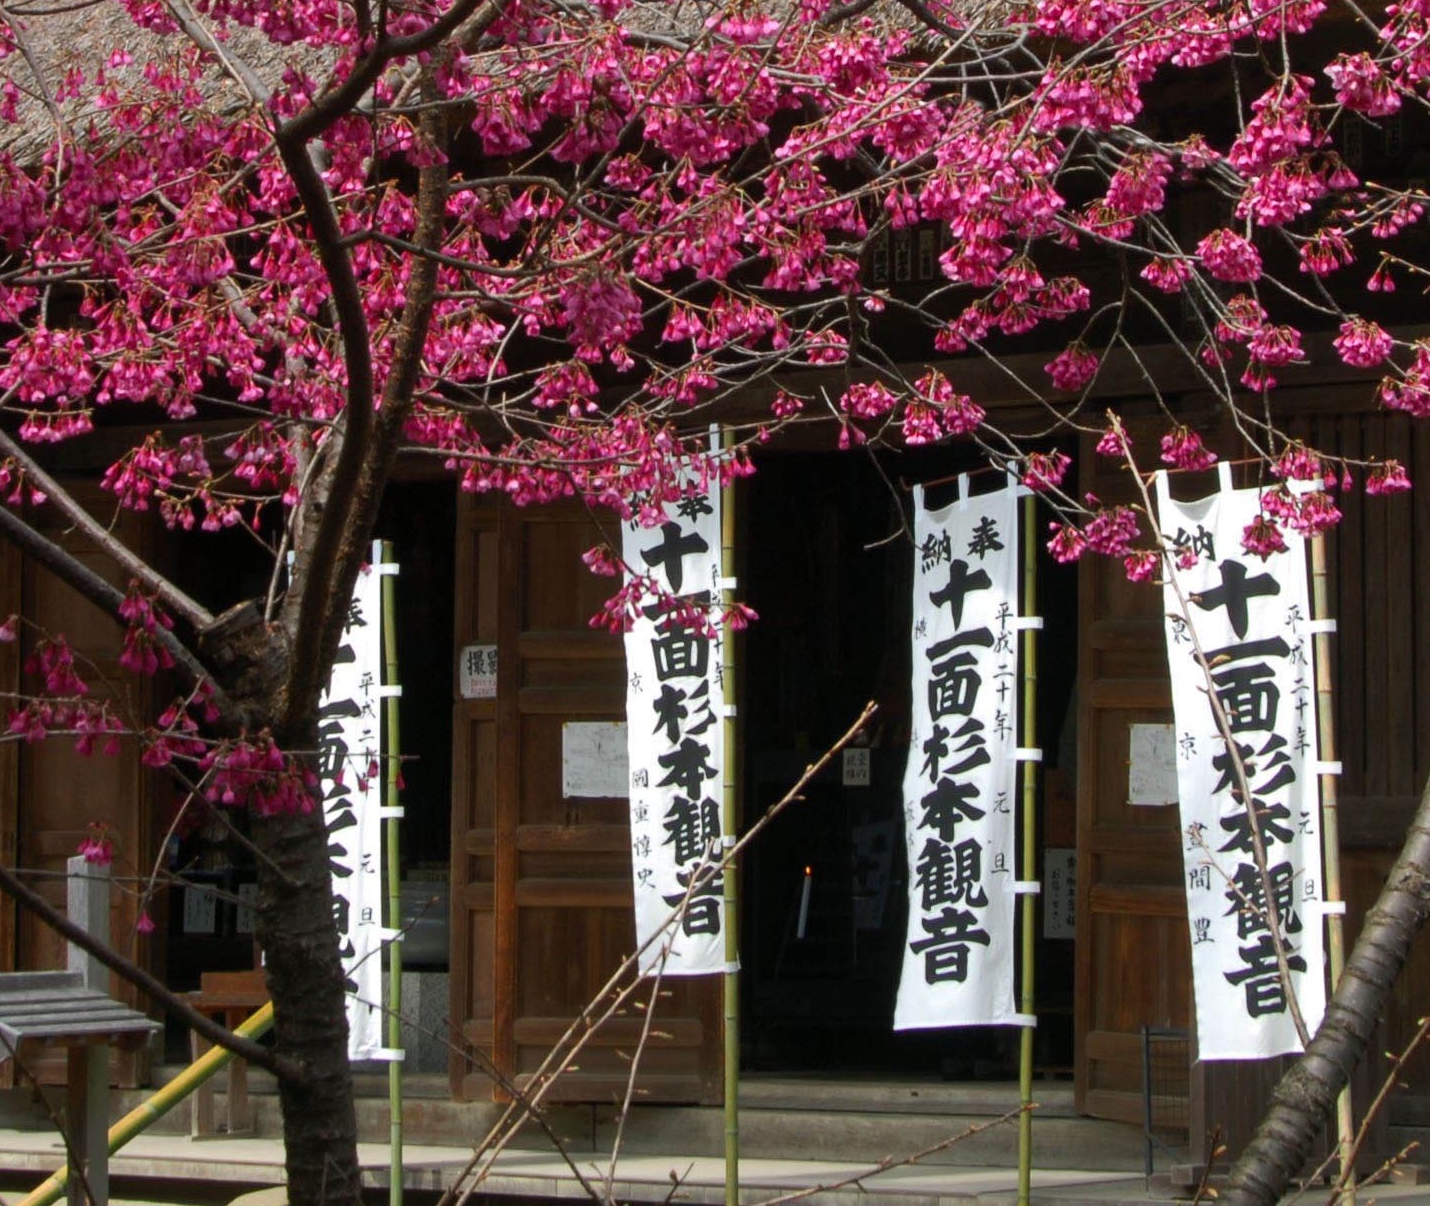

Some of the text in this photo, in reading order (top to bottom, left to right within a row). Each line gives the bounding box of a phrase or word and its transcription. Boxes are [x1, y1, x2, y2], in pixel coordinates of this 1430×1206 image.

[921, 515, 1005, 573] 奉納
[909, 558, 995, 986] 十一面杉本観音
[990, 601, 1014, 875] 平成二十年 元旦
[1171, 615, 1198, 761] 東京
[1187, 557, 1308, 1020] 十一面杉本観音
[1284, 603, 1319, 904] 平成二十年 元旦
[357, 852, 376, 927] 元旦
